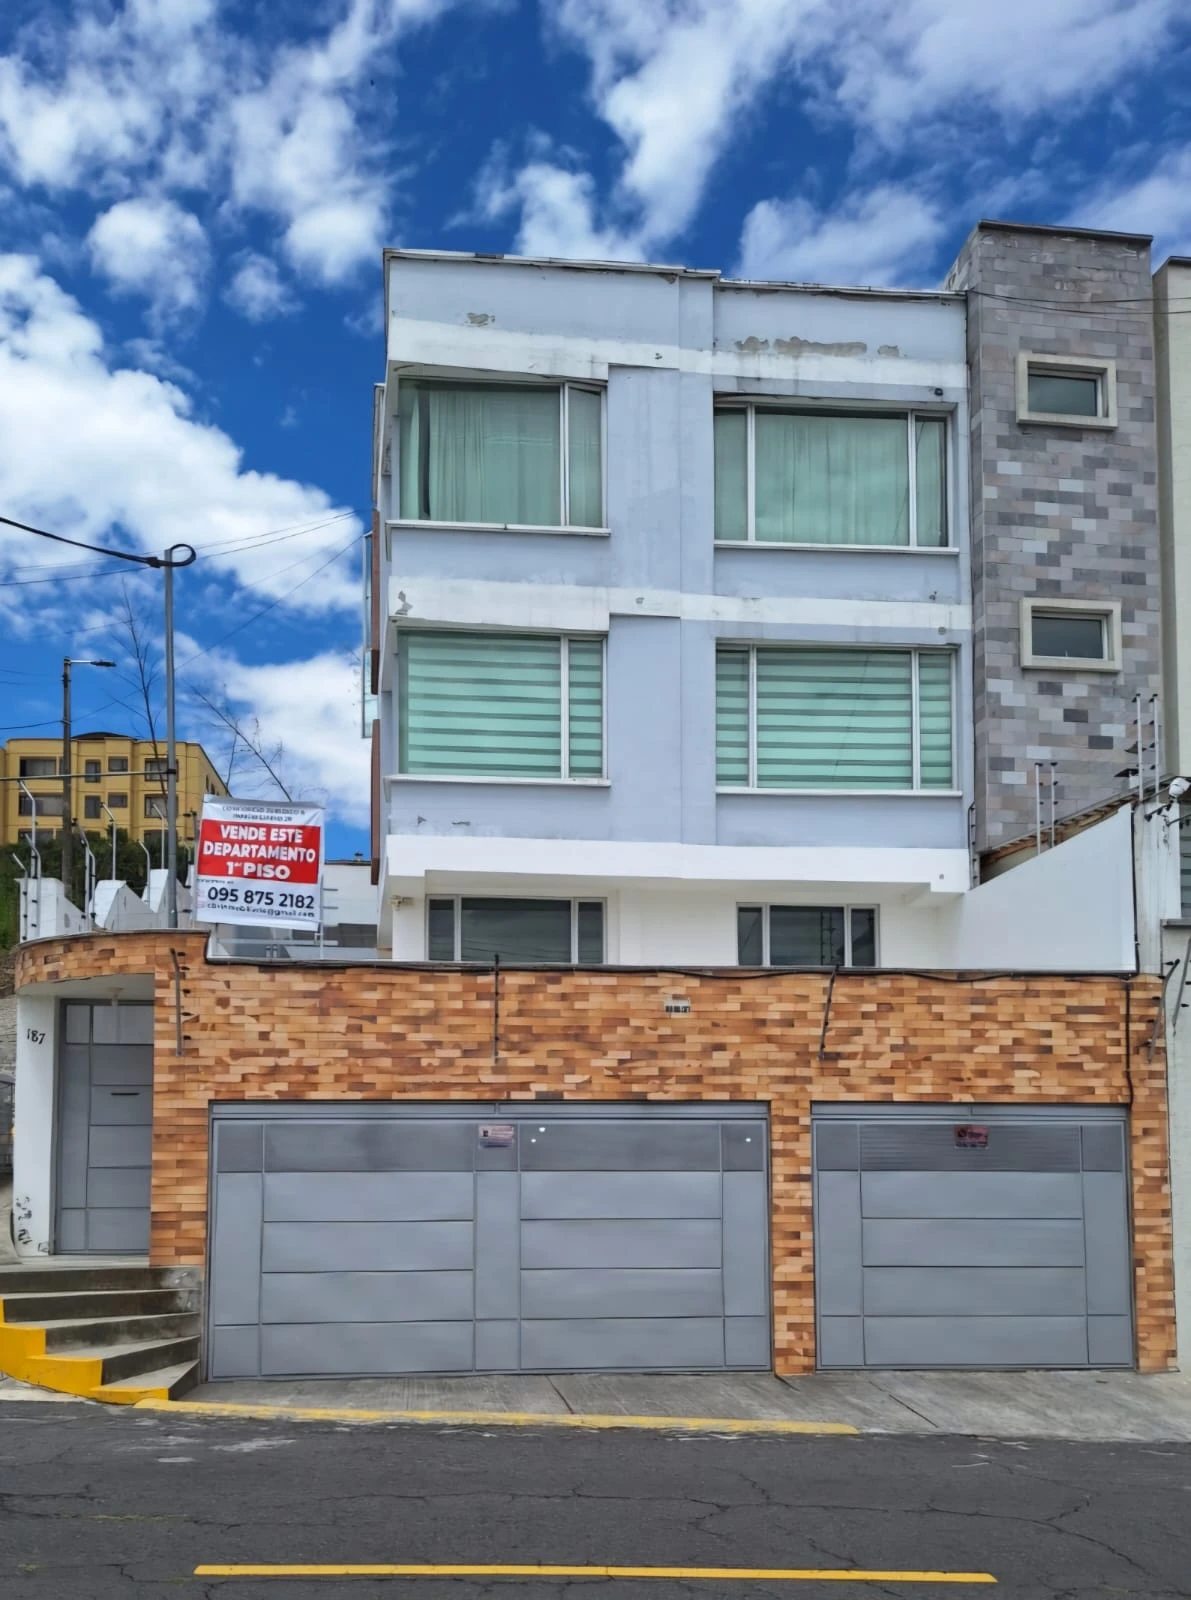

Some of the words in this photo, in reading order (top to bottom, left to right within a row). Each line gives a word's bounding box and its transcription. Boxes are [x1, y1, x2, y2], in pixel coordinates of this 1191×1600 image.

[220, 824, 266, 841] VENDE
[270, 828, 304, 843] ESTE
[203, 840, 316, 863] DEPARTAMENTO
[243, 862, 291, 880] PISO
[208, 886, 239, 902] 095
[243, 890, 274, 906] 875
[279, 893, 315, 910] 2182
[26, 1028, 46, 1045] 187
